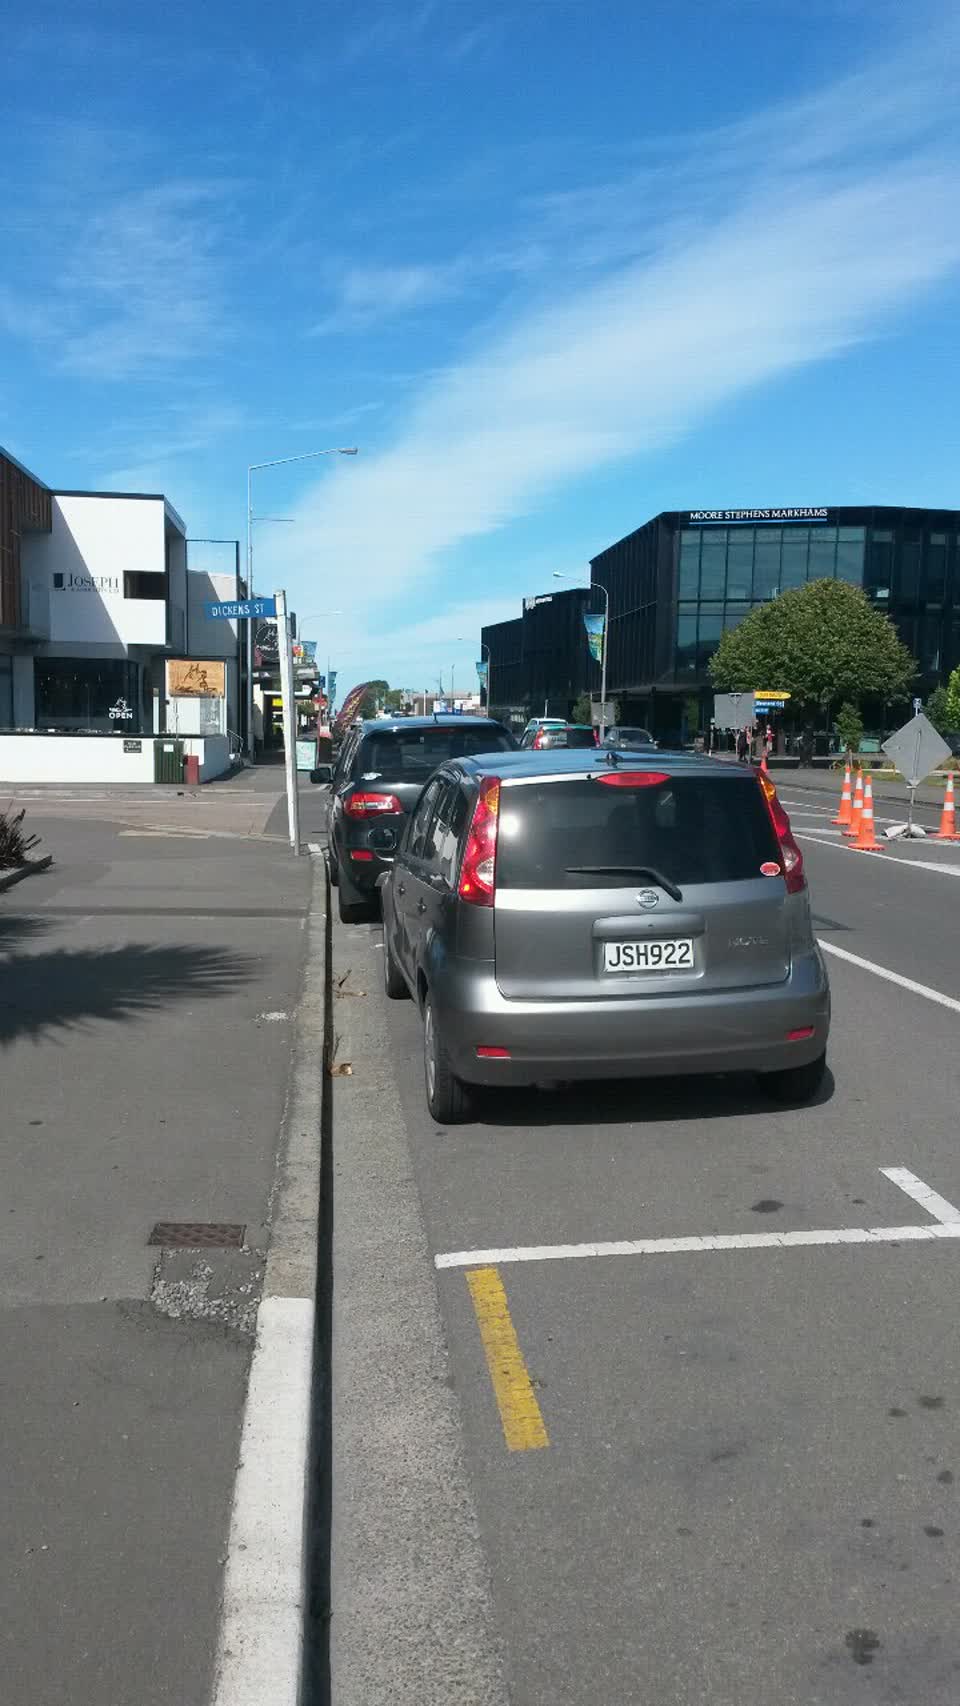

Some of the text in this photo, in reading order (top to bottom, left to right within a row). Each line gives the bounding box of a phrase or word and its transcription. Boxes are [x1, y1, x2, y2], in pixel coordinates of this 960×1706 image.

[689, 508, 828, 520] MOORE STEPHENS MARKHAMS
[67, 573, 119, 588] JOSEPH
[211, 603, 265, 617] DICKENS ST
[609, 943, 691, 967] JSH922
